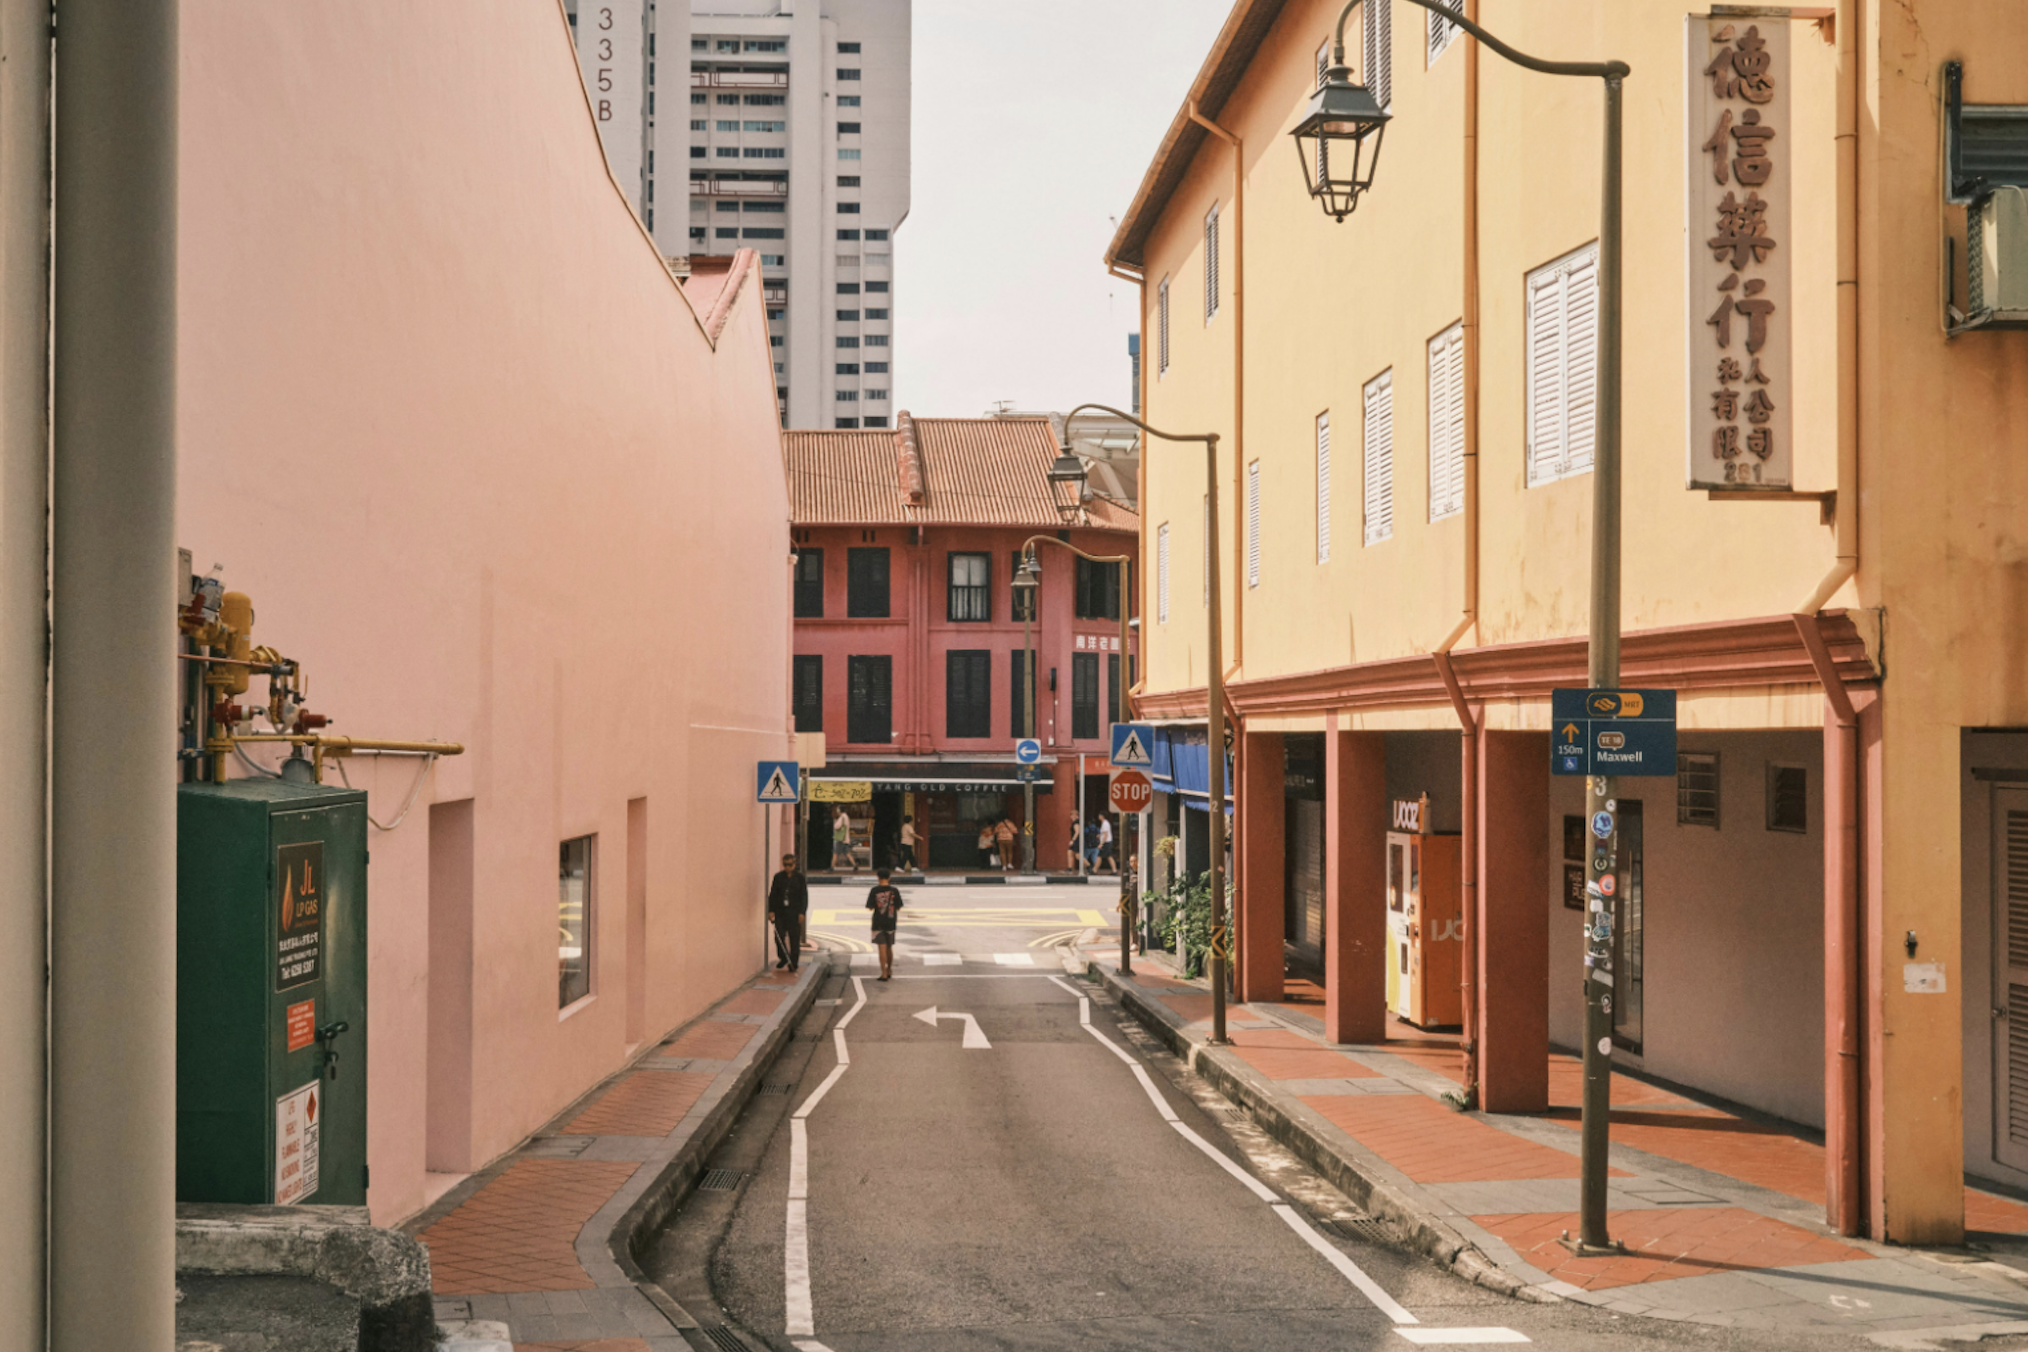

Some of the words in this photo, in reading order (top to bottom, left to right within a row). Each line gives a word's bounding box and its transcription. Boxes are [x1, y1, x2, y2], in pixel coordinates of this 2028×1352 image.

[598, 8, 613, 121] 335B
[1624, 700, 1640, 709] MRT
[1597, 751, 1643, 762] Maxwell
[920, 783, 946, 792] OLD
[955, 784, 1007, 792] COFFEE
[1112, 782, 1151, 801] STOP
[300, 859, 316, 897] JL
[305, 898, 318, 916] GAS
